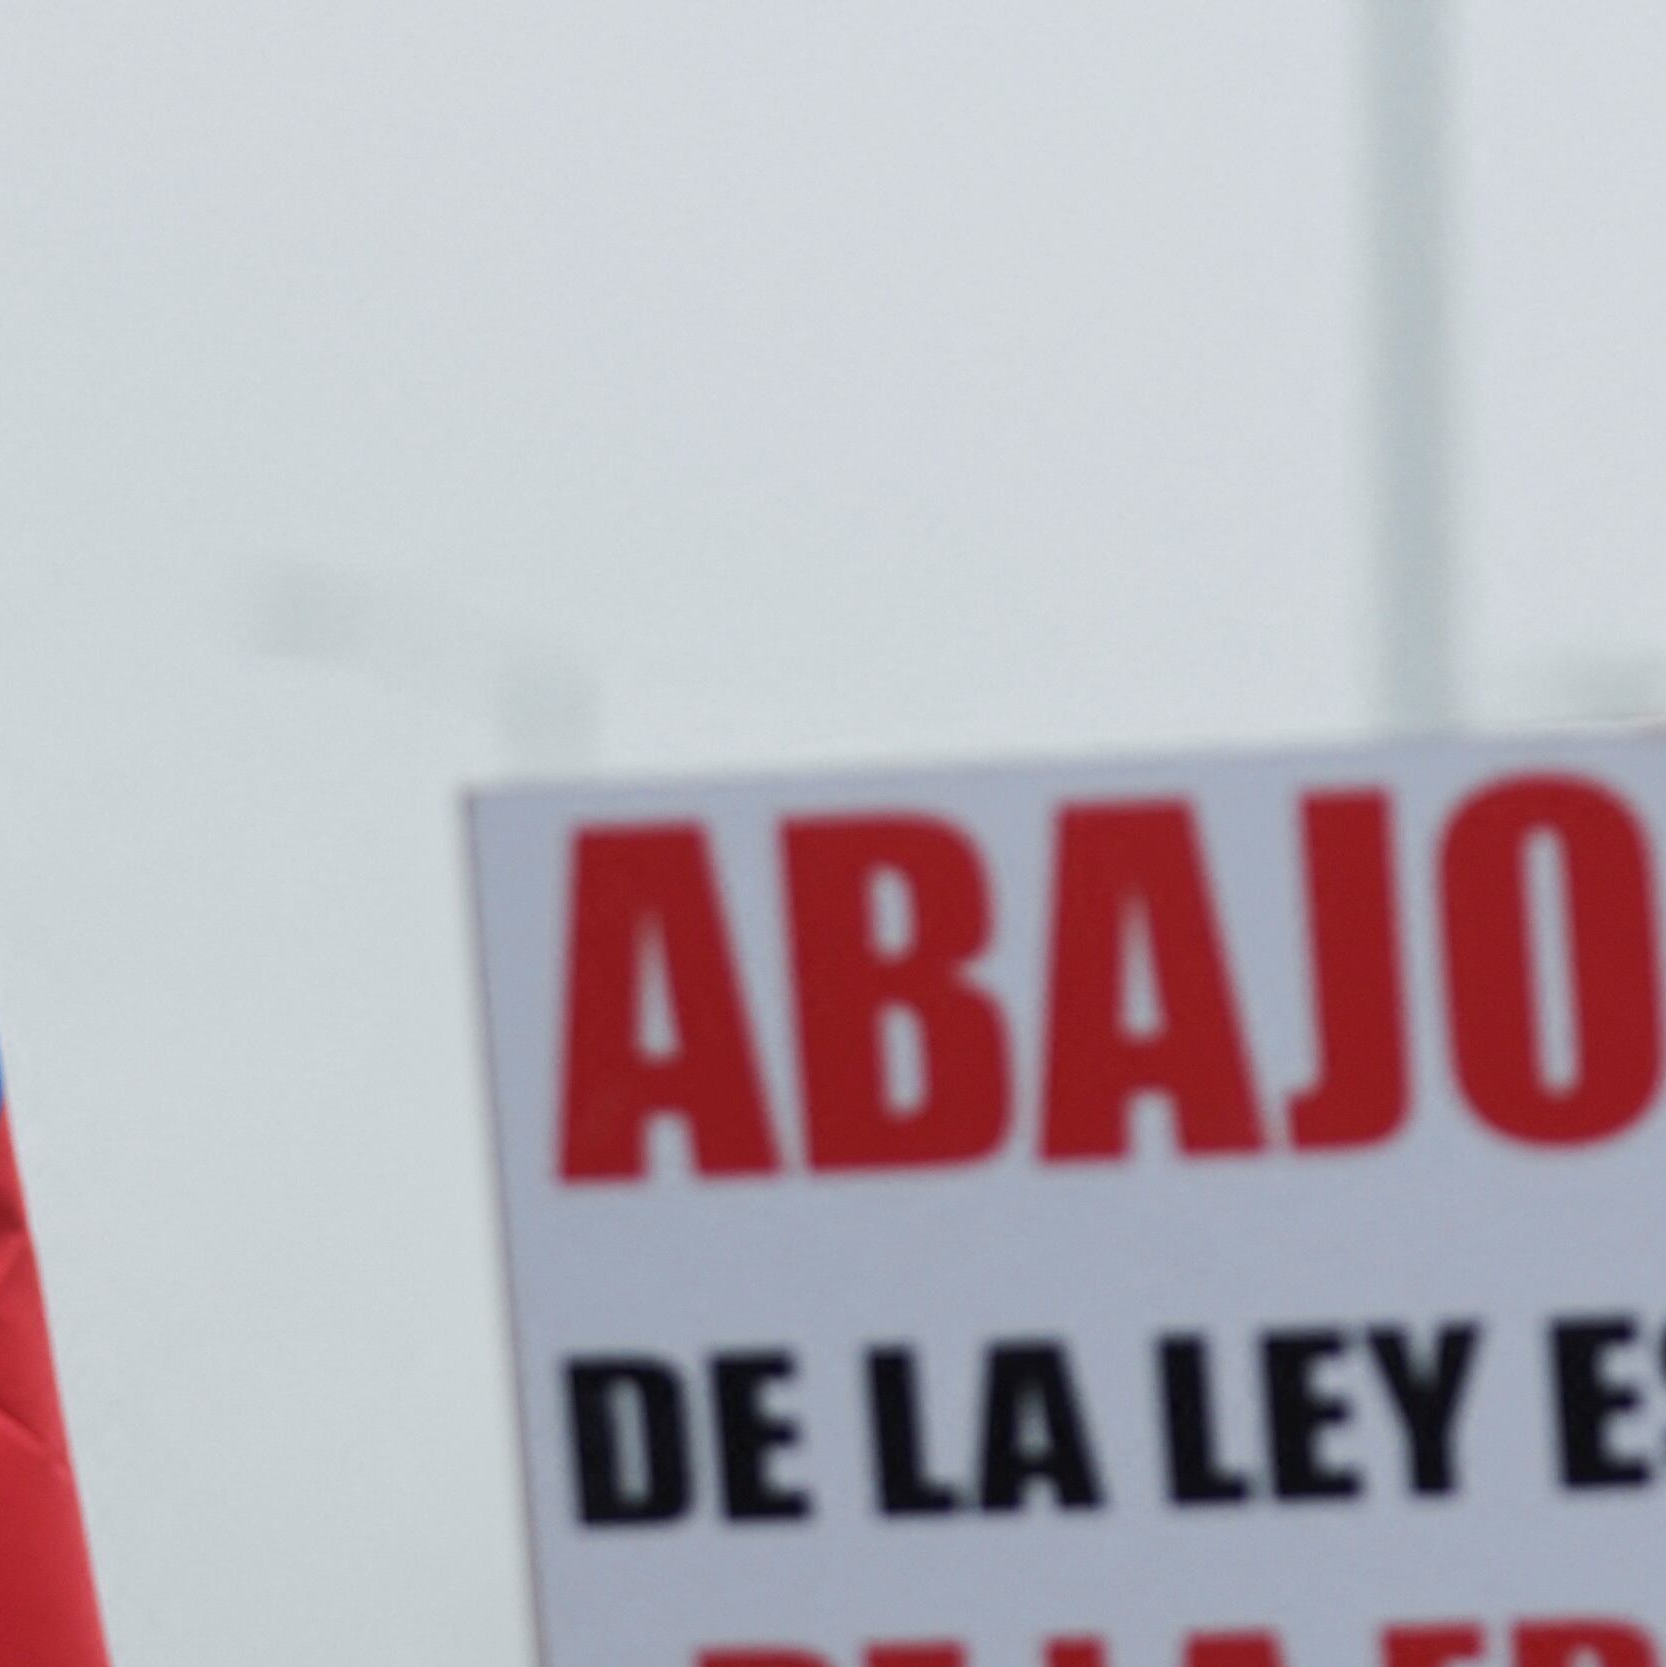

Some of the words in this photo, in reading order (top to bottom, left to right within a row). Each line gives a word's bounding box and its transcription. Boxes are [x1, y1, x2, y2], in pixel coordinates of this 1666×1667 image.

[558, 775, 1666, 1184] ABAJO
[564, 1350, 811, 1528] DE
[864, 1340, 1103, 1518] LA
[1156, 1323, 1479, 1507] LEY
